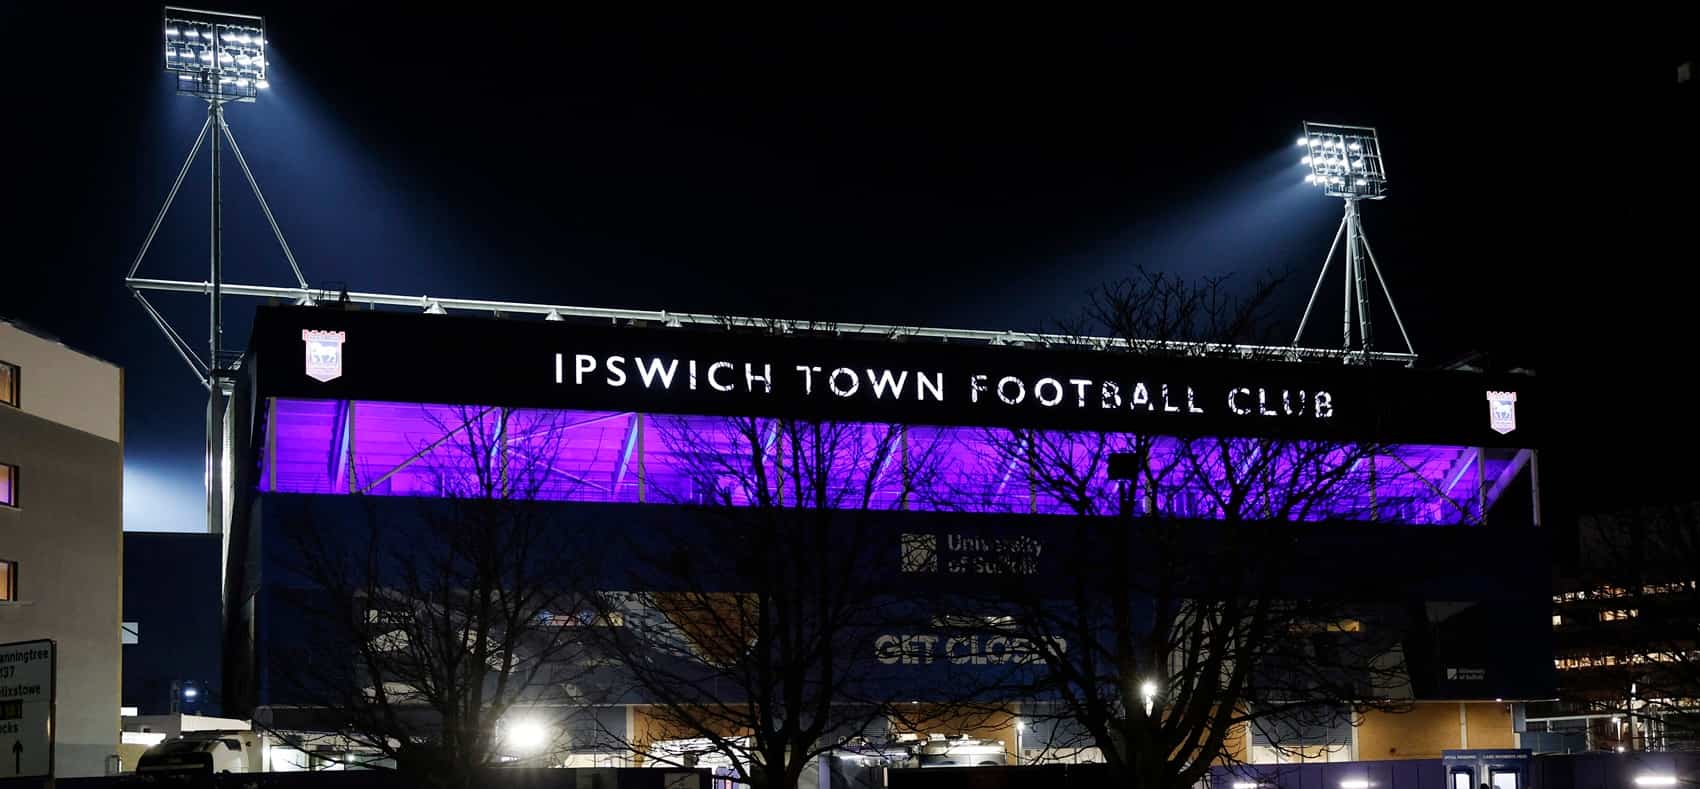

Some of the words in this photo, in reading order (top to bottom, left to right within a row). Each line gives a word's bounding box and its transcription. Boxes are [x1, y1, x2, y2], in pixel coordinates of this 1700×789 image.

[555, 353, 772, 393] IPSWICH
[796, 364, 945, 401] TOWN
[971, 374, 1204, 414] FOOTBALL
[1227, 387, 1334, 418] CLUB
[873, 633, 940, 665] GET
